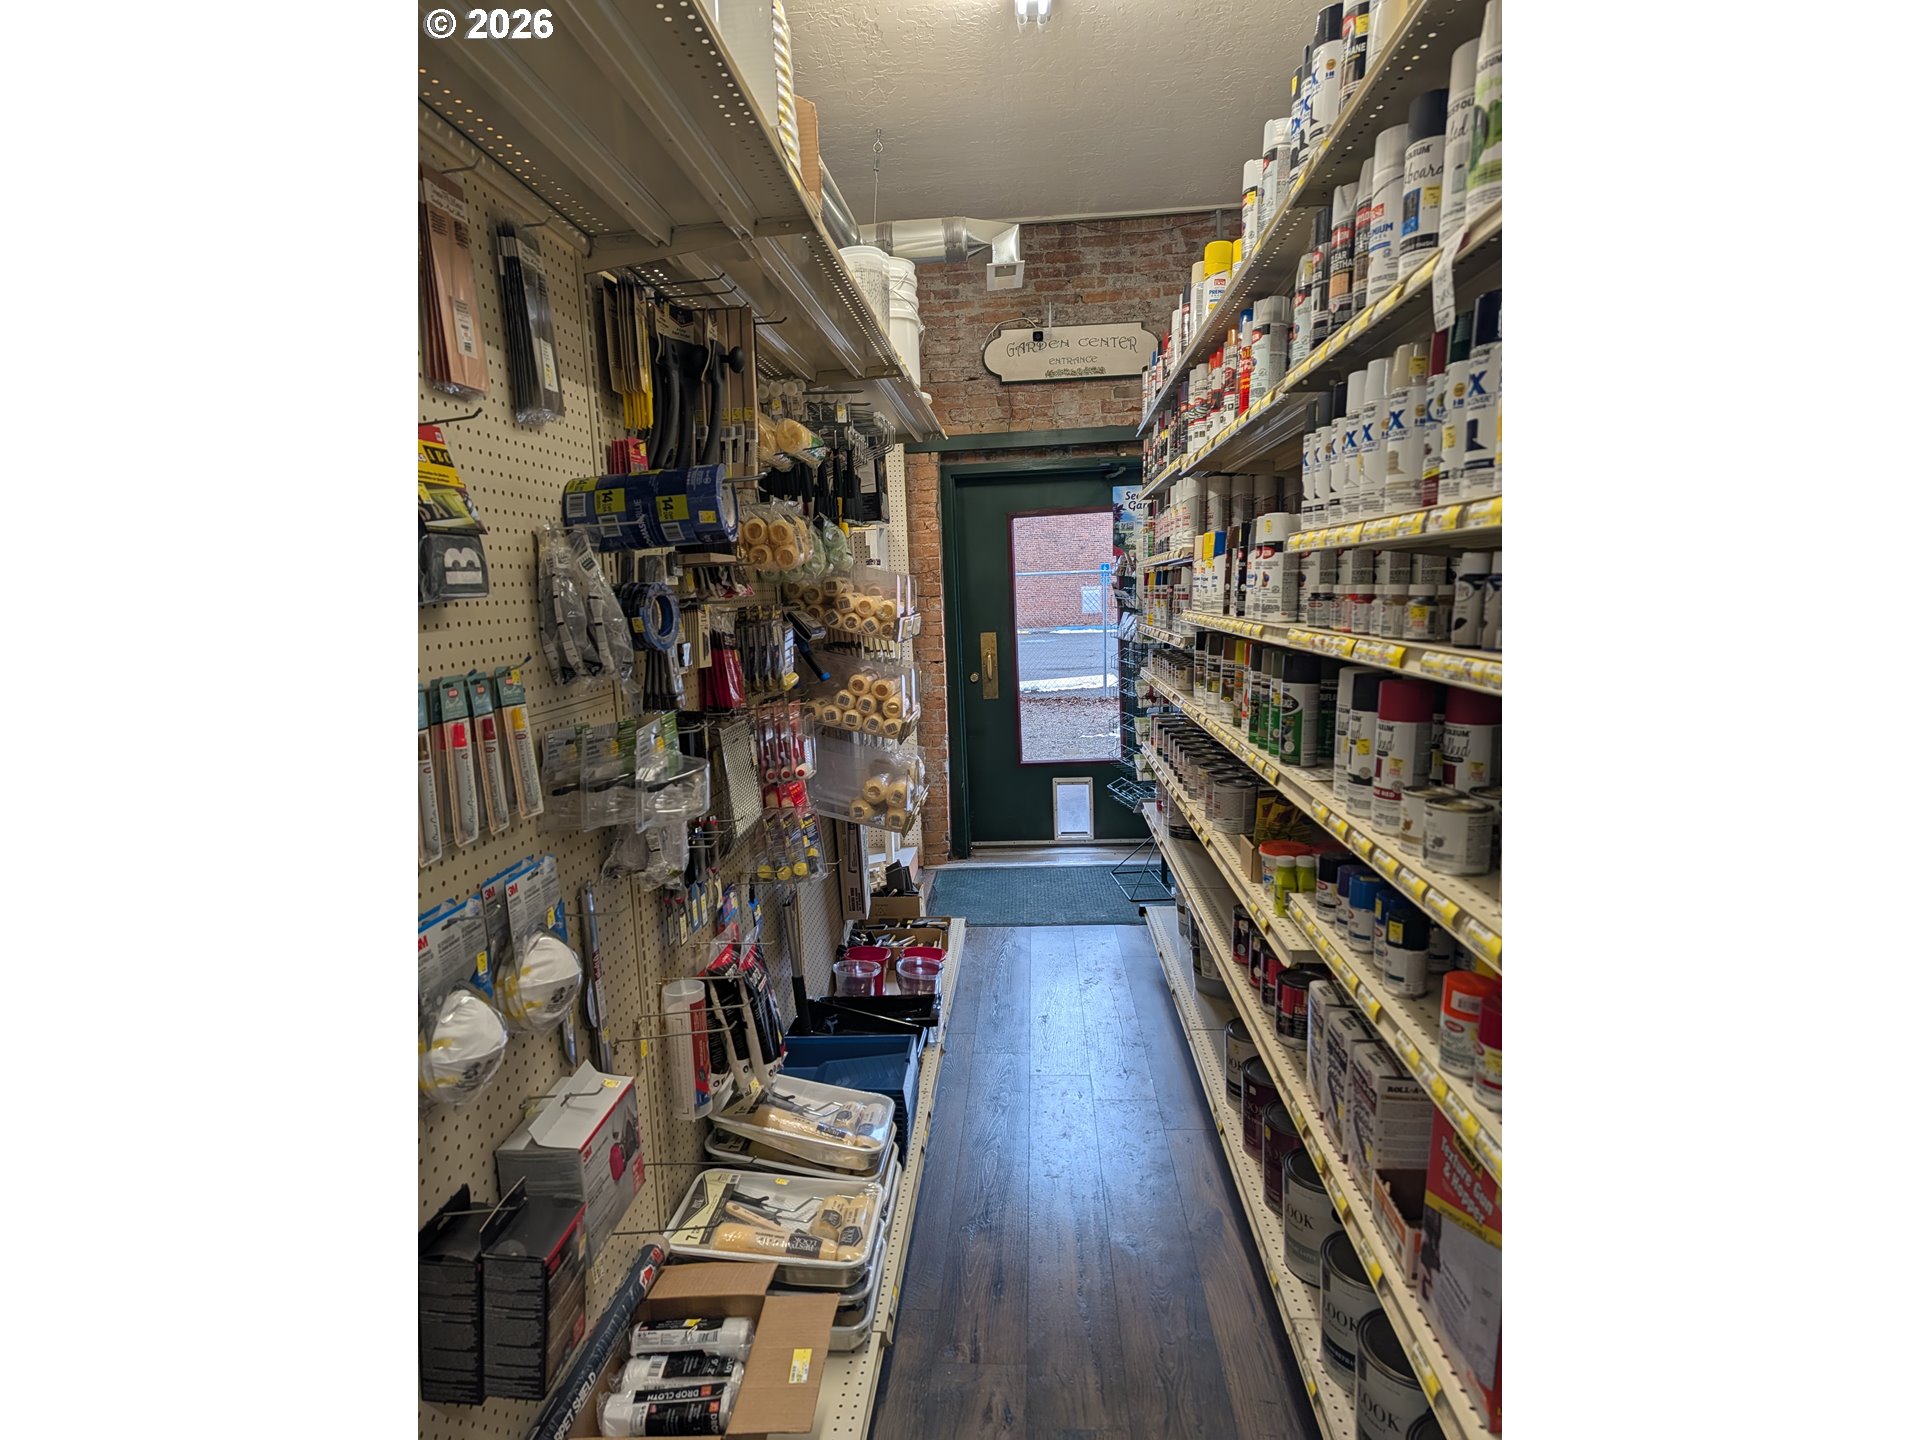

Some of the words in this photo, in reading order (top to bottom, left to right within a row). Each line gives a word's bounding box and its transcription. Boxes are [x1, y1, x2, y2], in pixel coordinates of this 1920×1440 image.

[1006, 338, 1070, 358] GARDEN
[1078, 336, 1138, 353] CENTER
[1048, 355, 1098, 365] ENTRANCE
[484, 886, 496, 901] 3M
[508, 884, 518, 898] 3M
[572, 1372, 598, 1413] SHIELD
[646, 1390, 675, 1401] CLOTH
[674, 1388, 700, 1399] DROP
